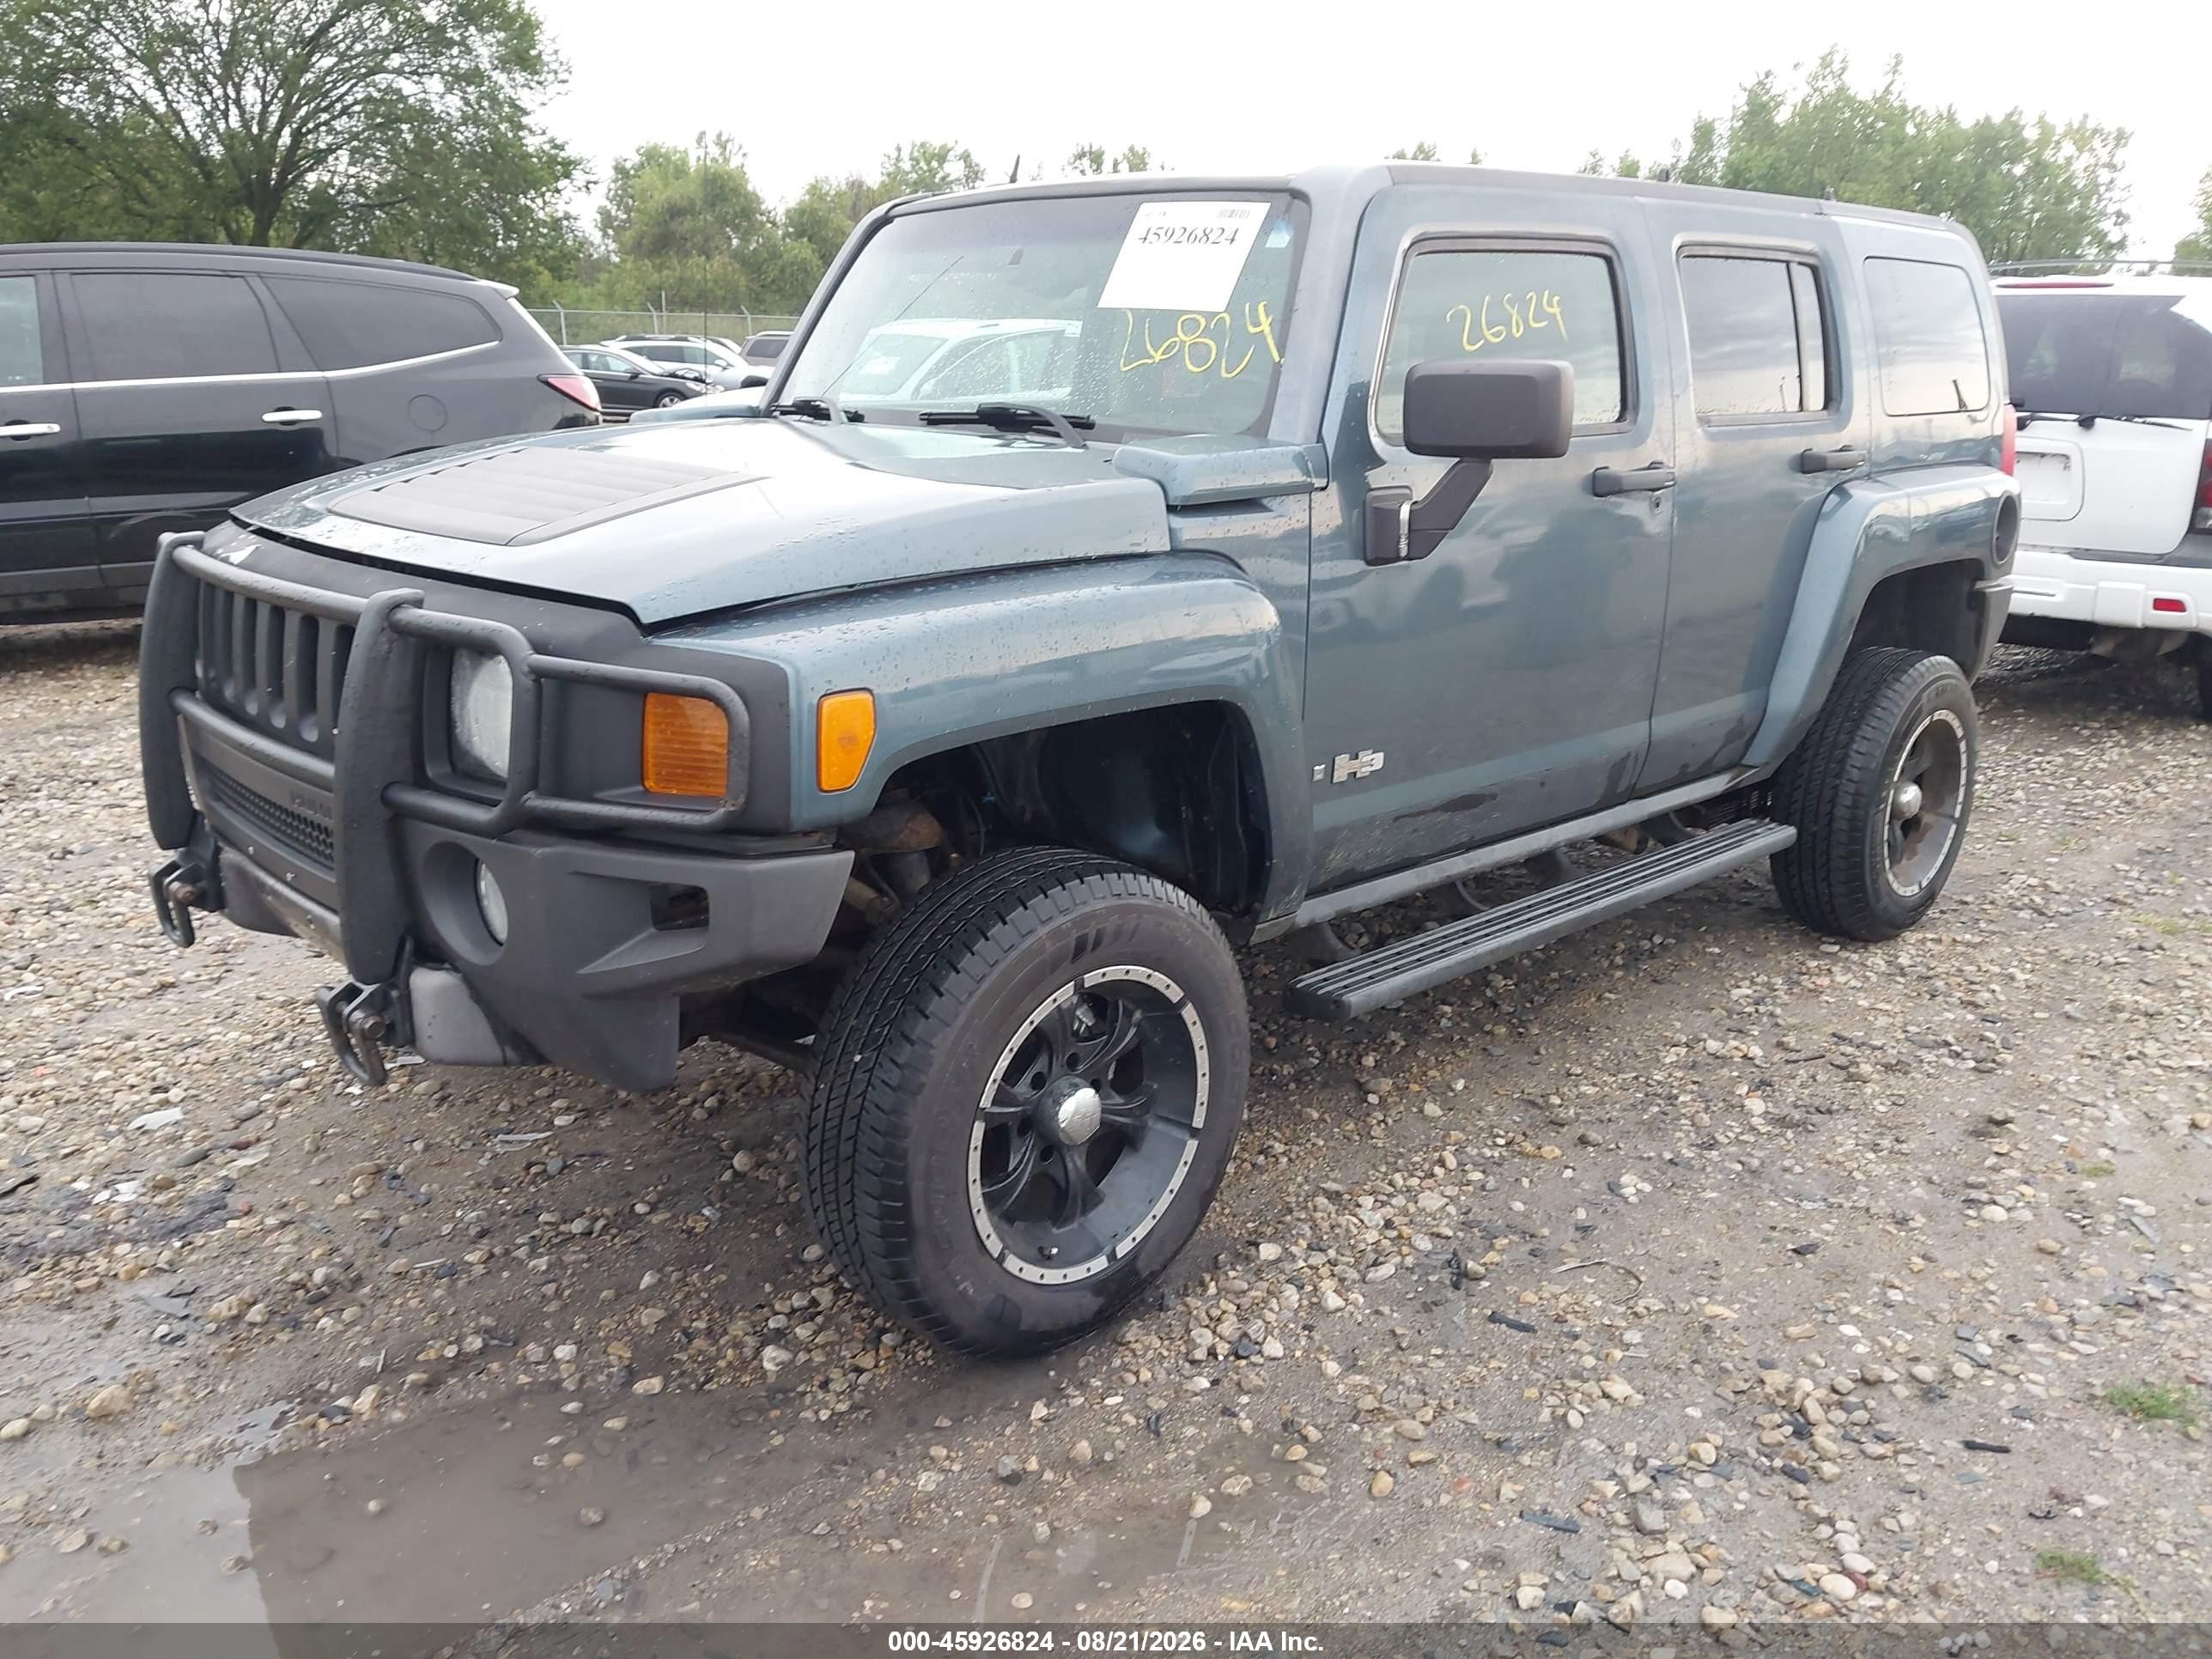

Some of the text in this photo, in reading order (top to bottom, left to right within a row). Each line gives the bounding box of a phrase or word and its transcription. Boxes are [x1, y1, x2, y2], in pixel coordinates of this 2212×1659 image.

[1138, 226, 1239, 246] 45926824
[1120, 301, 1280, 379] 26824
[1446, 289, 1569, 352] 26824
[1331, 749, 1385, 784] H3
